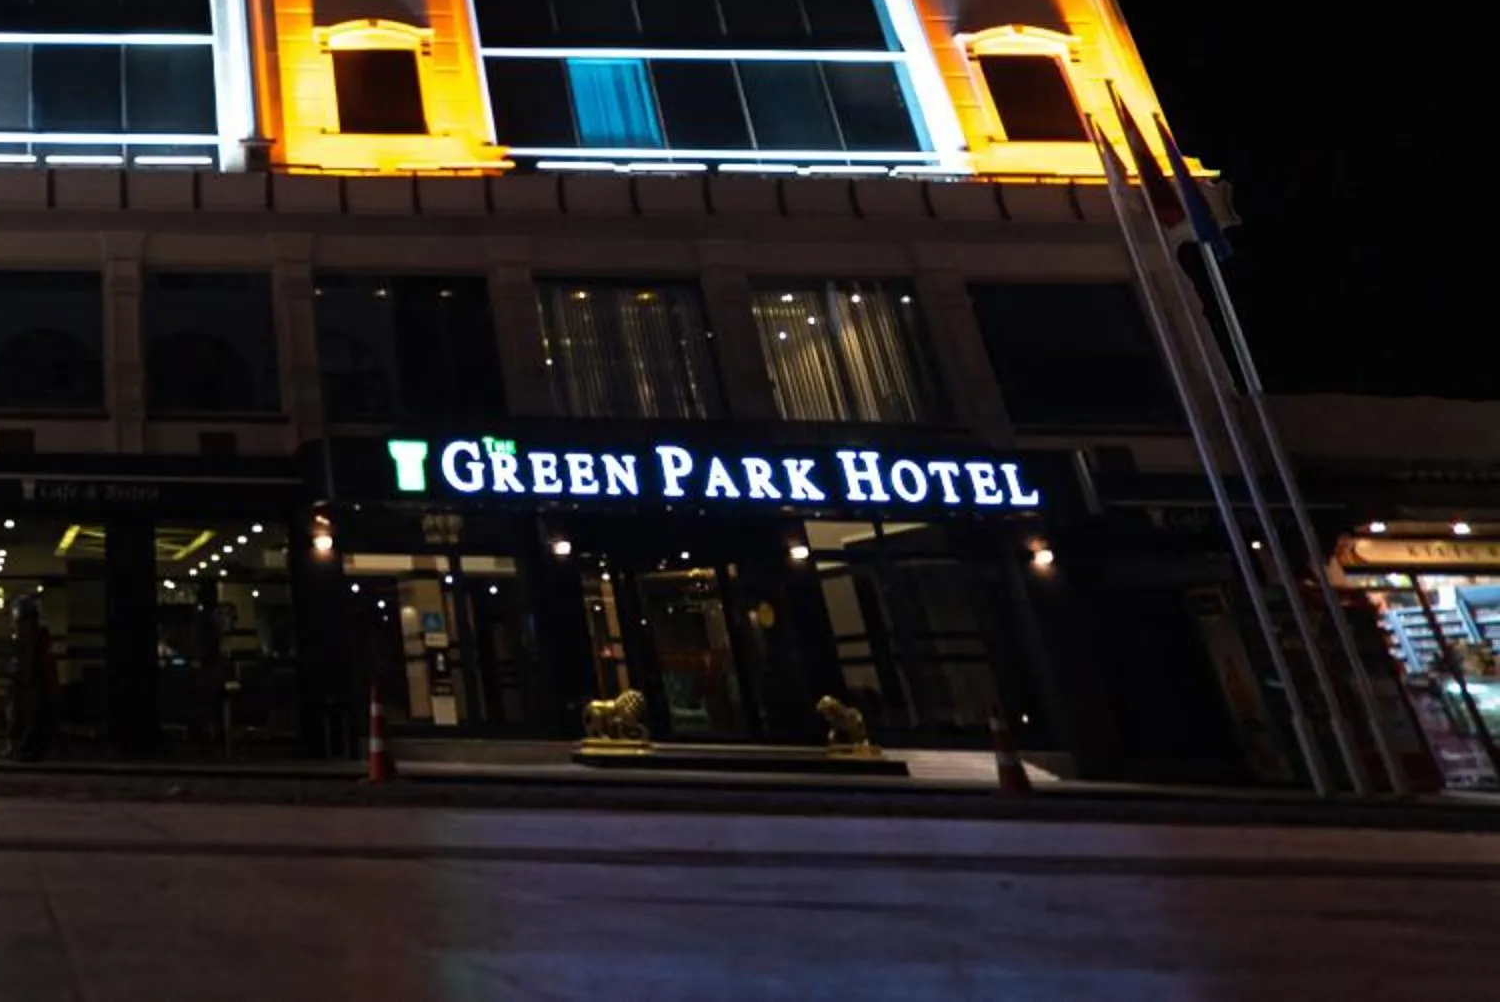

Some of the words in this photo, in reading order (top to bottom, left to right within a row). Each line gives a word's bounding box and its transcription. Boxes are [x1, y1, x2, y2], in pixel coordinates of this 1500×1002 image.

[441, 440, 639, 493] GREEN
[655, 445, 825, 500] PARK
[836, 451, 1039, 506] HOTEL
